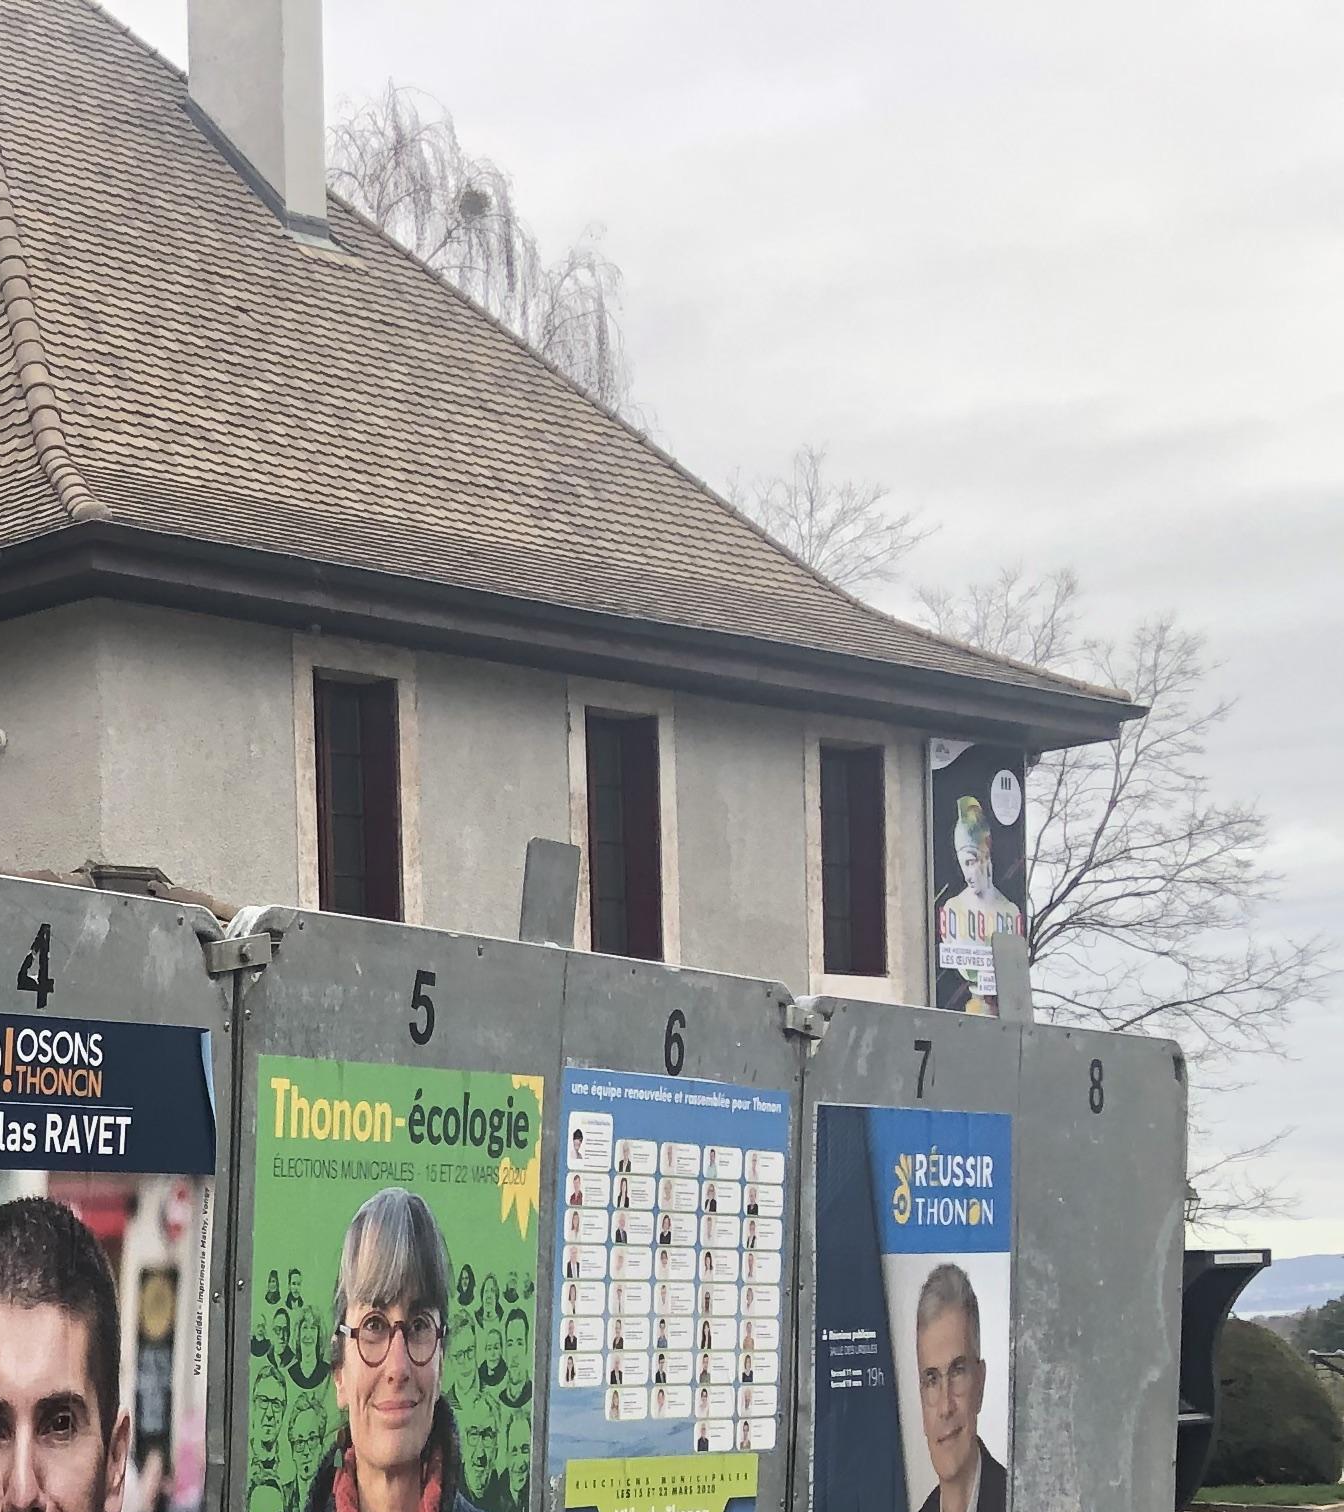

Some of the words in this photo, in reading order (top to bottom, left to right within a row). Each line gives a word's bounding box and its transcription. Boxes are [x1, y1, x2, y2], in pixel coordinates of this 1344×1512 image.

[17, 923, 54, 1008] 4
[941, 955, 954, 967] LES
[409, 970, 436, 1045] 5
[16, 1029, 103, 1067] OSONS
[664, 1009, 687, 1076] 6
[16, 1066, 103, 1098] THONON
[914, 1040, 932, 1098] 7
[1089, 1059, 1103, 1114] 8
[271, 1077, 529, 1158] Thonon-écologie
[571, 1082, 589, 1095] une
[591, 1080, 621, 1101] équipe
[624, 1086, 672, 1103] renouvelée
[685, 1092, 729, 1108] rassemblée
[732, 1098, 751, 1113] pour
[753, 1097, 782, 1113] Thonon
[45, 1113, 132, 1155] RAVET
[916, 1145, 993, 1188] RÉUSSIR
[916, 1198, 994, 1226] THONON
[866, 1367, 884, 1387] 19h
